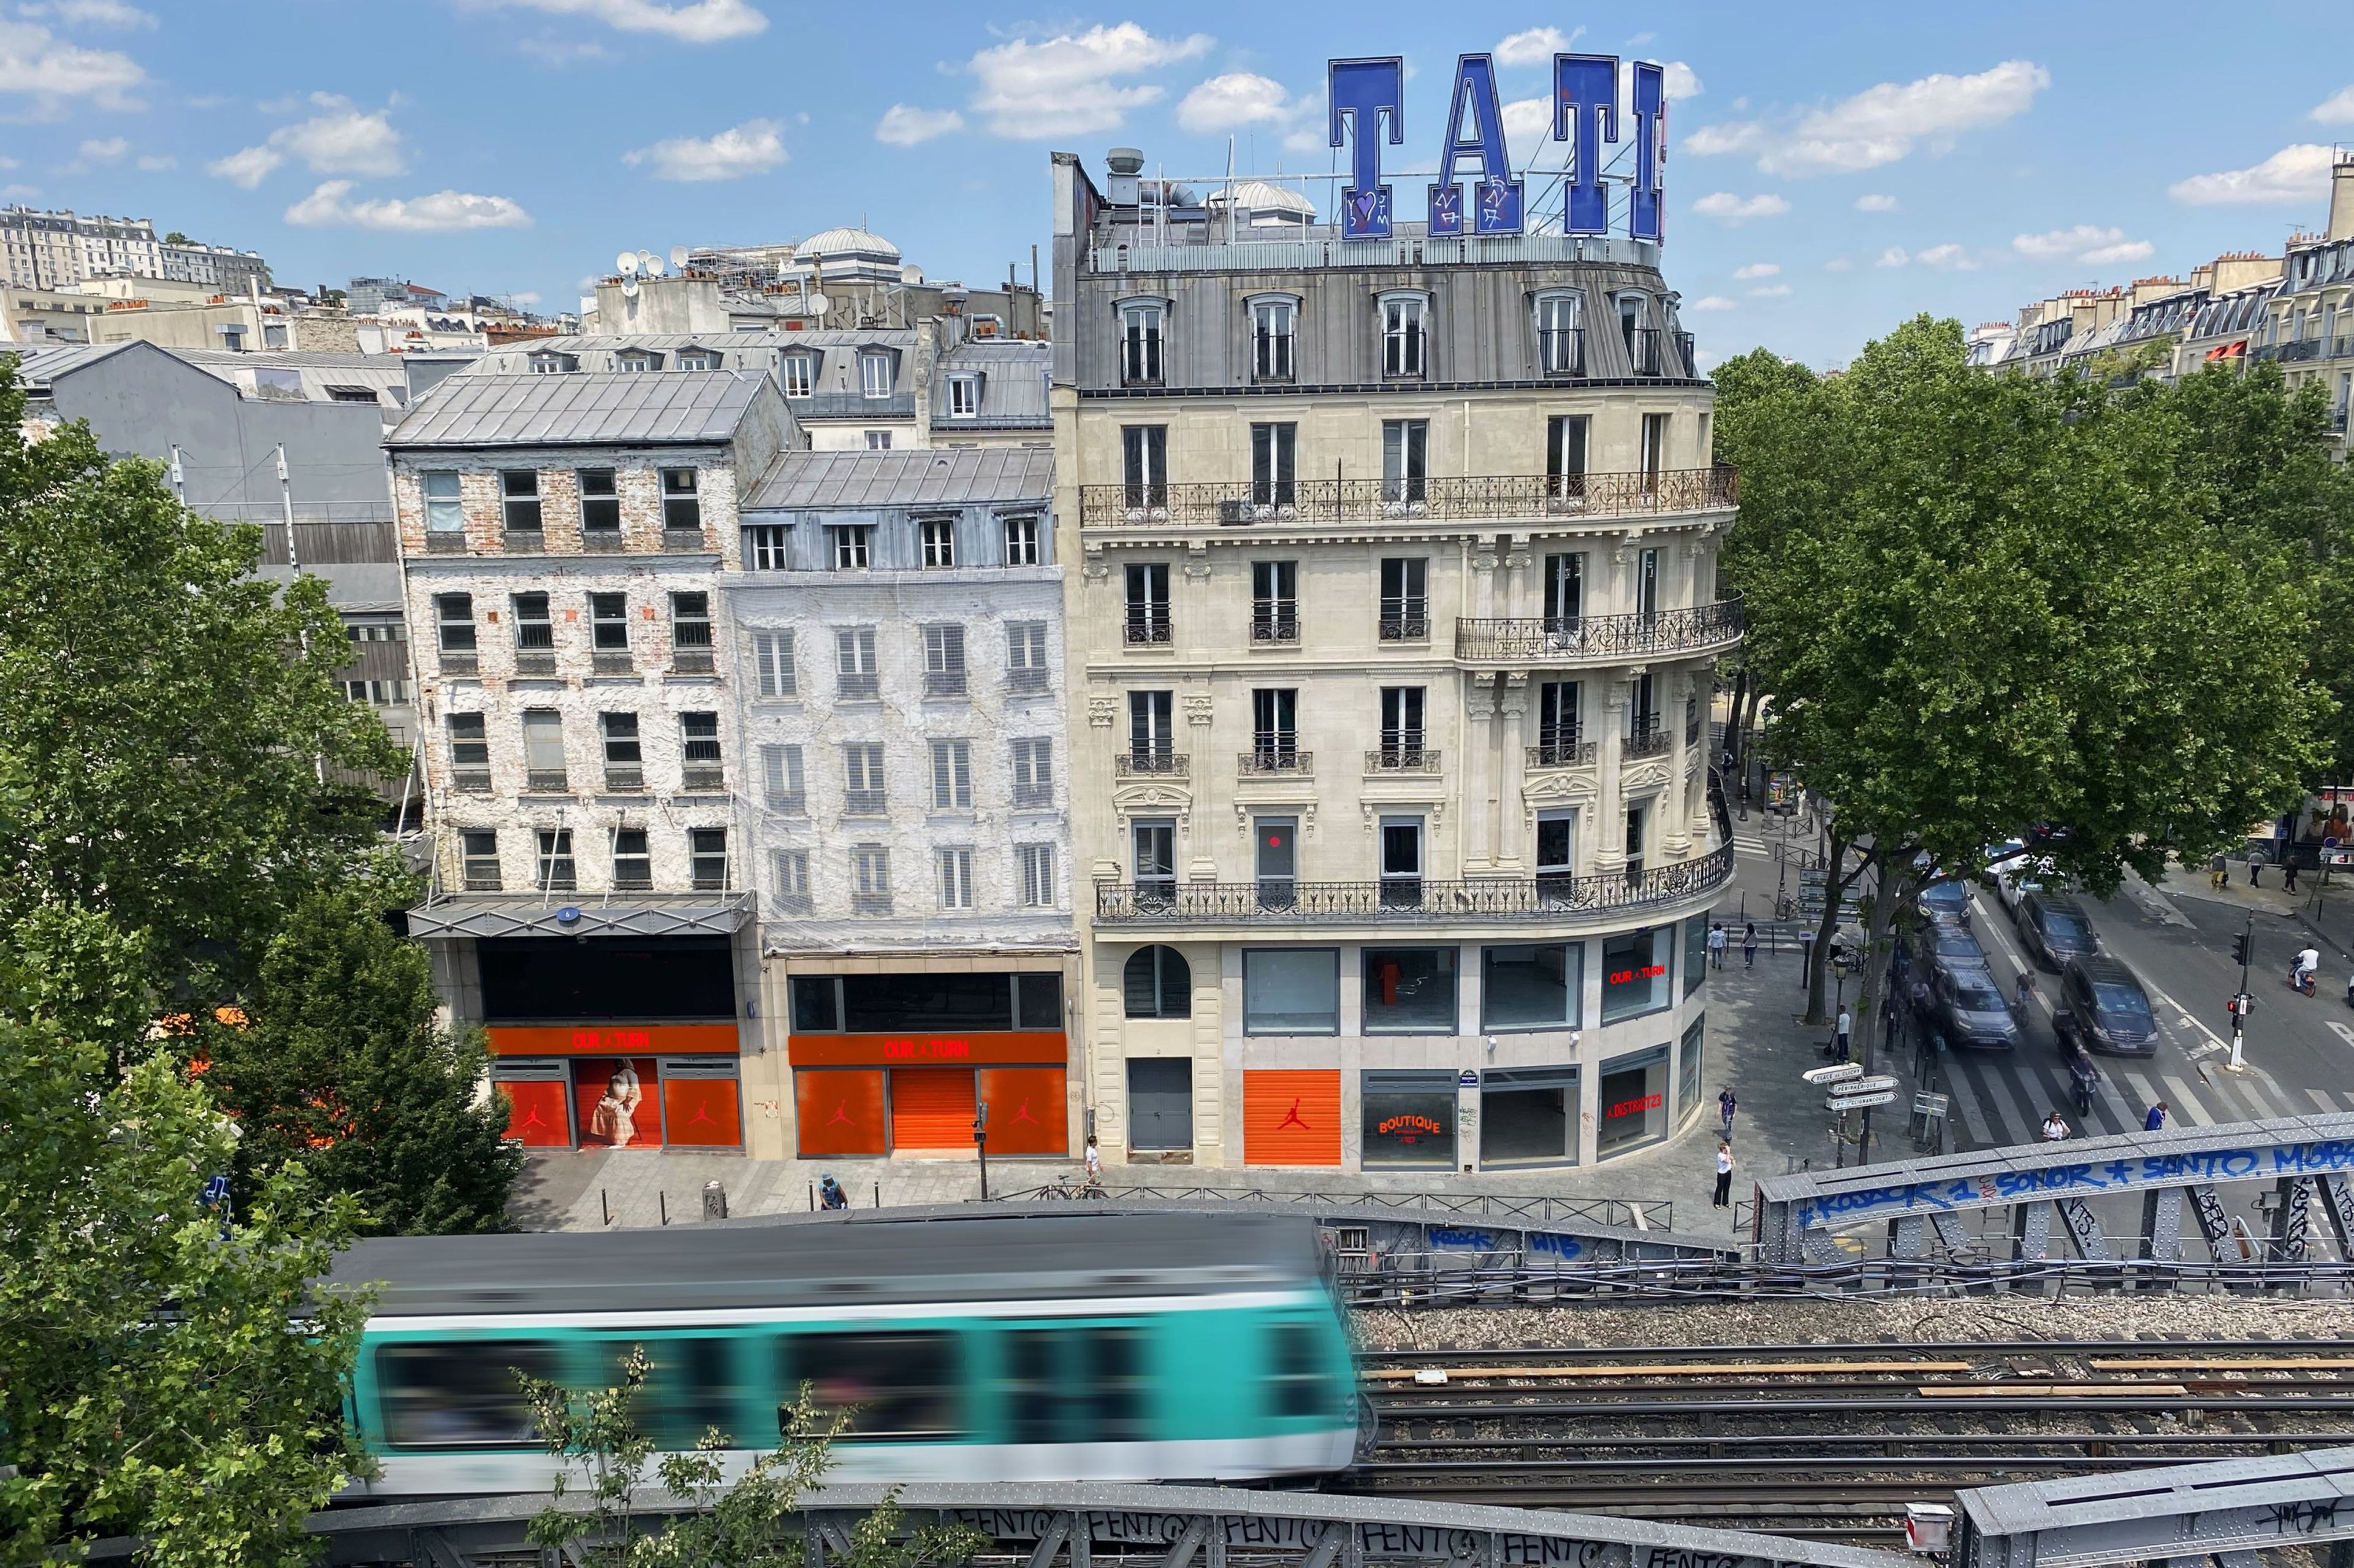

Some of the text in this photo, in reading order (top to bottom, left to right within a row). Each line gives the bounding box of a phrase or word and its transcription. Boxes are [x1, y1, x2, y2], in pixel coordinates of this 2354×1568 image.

[1328, 53, 1664, 240] TATI
[1609, 964, 1665, 984] OUR TURN
[573, 1032, 649, 1048] OUR TURN
[884, 1040, 968, 1059] OUR TURN
[1837, 1083, 1876, 1091] PÉRIPHÉRIQUE
[1651, 1094, 1661, 1109] 23
[1851, 1095, 1887, 1105] CLIGNANCOURT
[1379, 1115, 1441, 1133] BOUTIQUE
